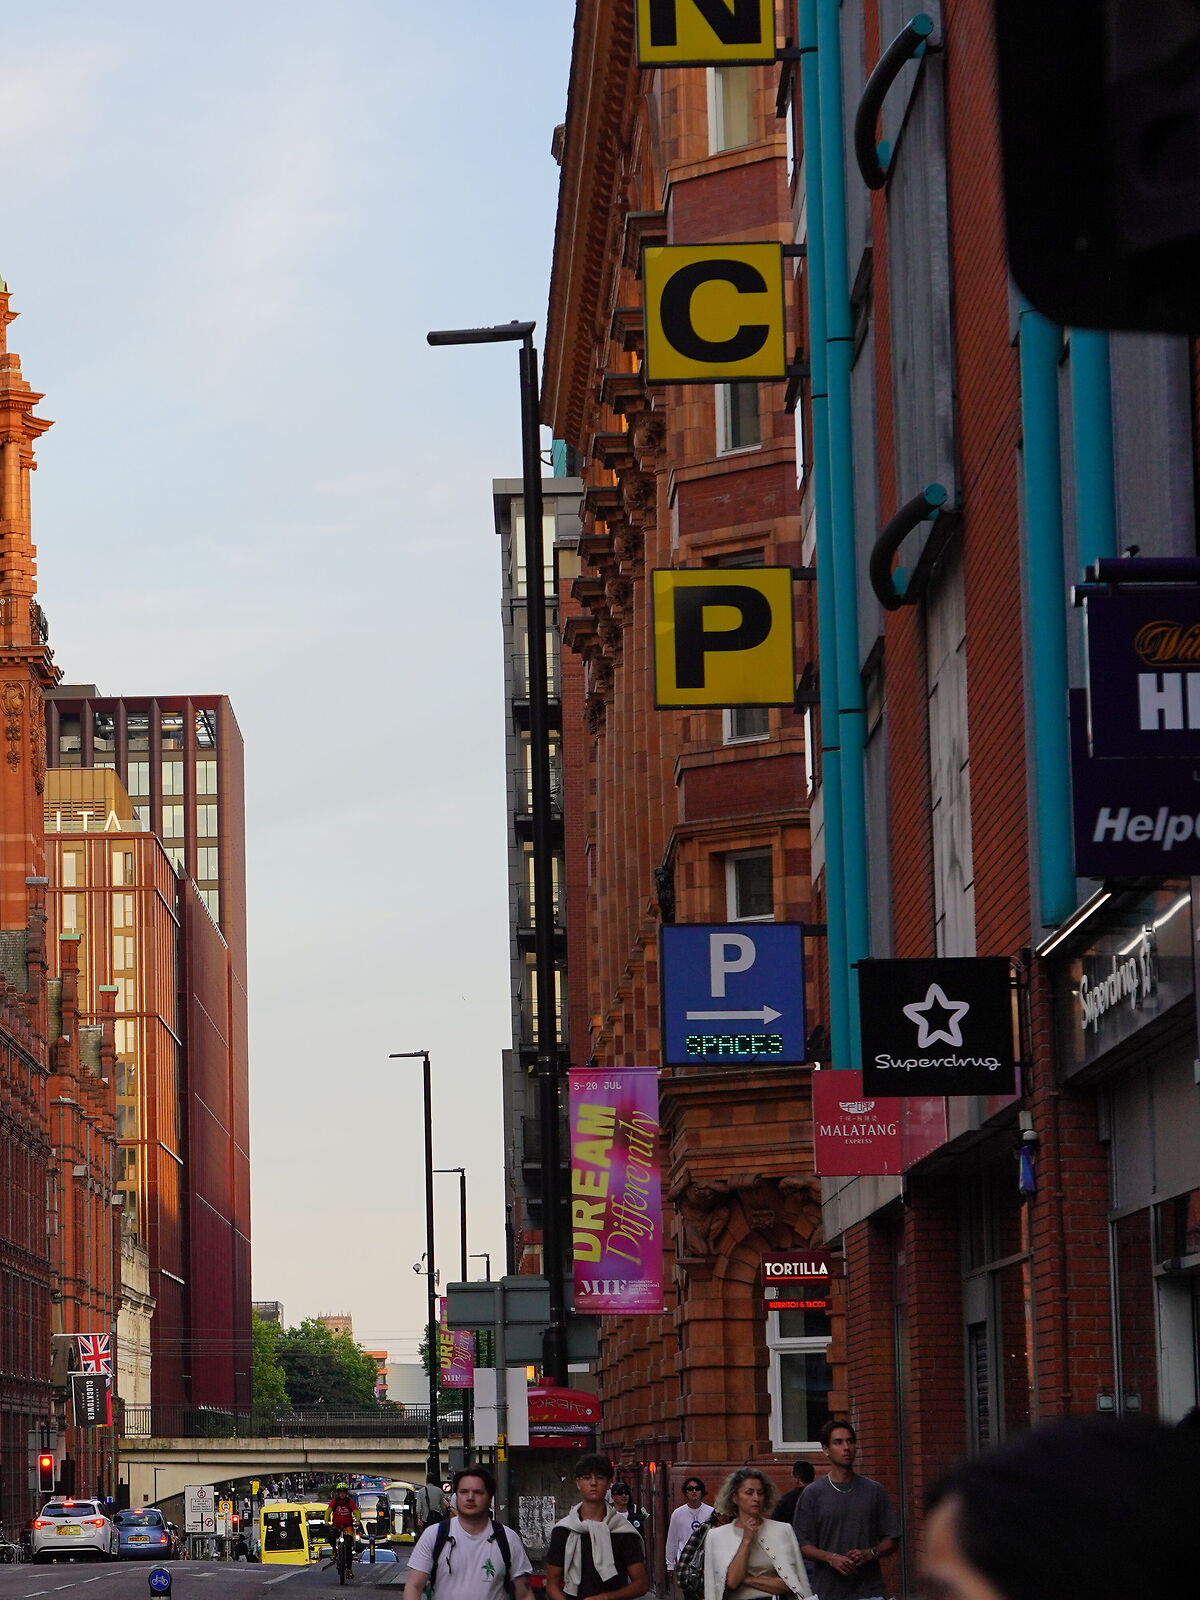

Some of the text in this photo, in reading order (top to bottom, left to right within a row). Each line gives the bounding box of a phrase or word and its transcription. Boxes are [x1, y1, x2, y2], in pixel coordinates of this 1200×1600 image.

[660, 259, 770, 363] C
[675, 585, 772, 689] P
[1093, 806, 1200, 850] Help
[710, 933, 756, 998] P
[686, 1035, 783, 1054] SPACES
[875, 1054, 1001, 1071] Superdrug
[604, 1081, 622, 1090] JUL
[820, 1124, 897, 1136] MALATANG
[572, 1104, 616, 1262] DREAM
[606, 1111, 659, 1264] Differently
[765, 1262, 828, 1275] TORTILLA
[86, 1380, 95, 1421] CLOCKTOWER
